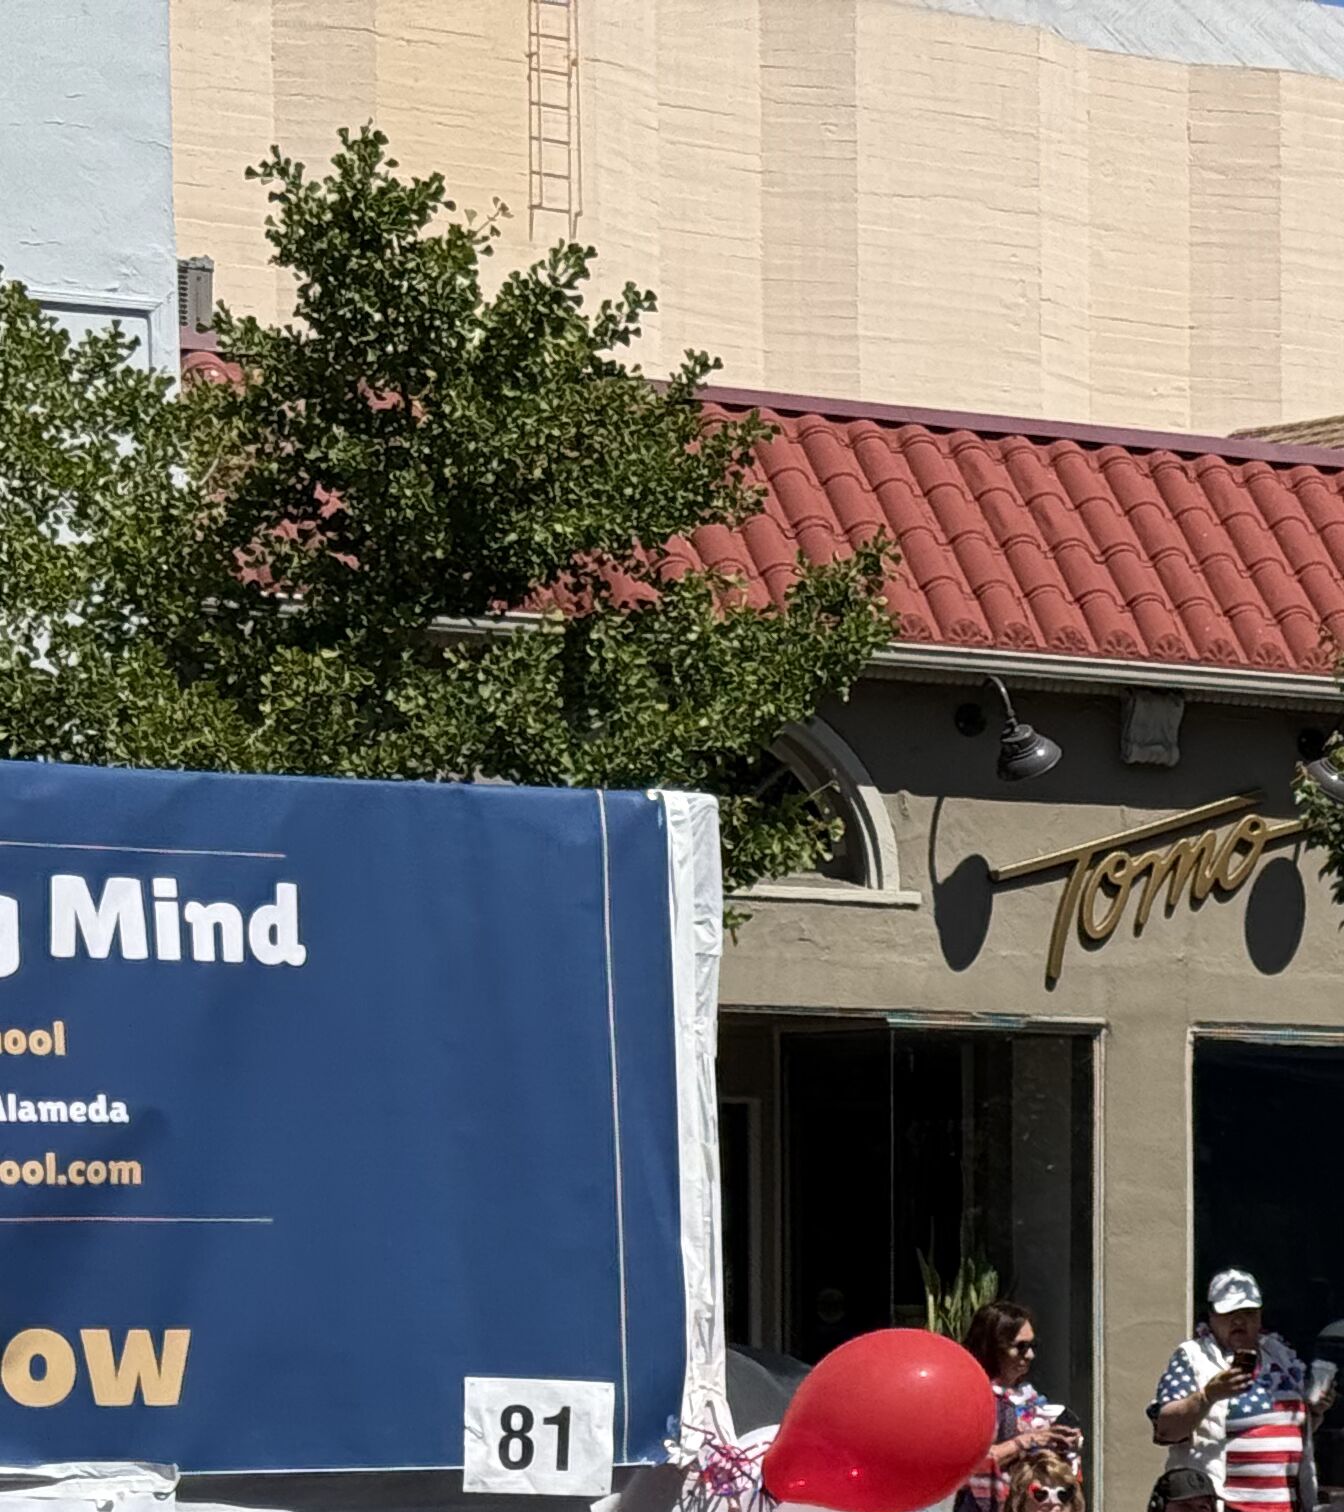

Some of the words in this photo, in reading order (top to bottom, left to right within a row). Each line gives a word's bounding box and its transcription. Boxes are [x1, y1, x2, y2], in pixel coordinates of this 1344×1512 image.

[51, 874, 306, 966] Mind
[991, 790, 1304, 984] Tomo
[0, 1020, 66, 1056] ool
[498, 1405, 571, 1472] 81
